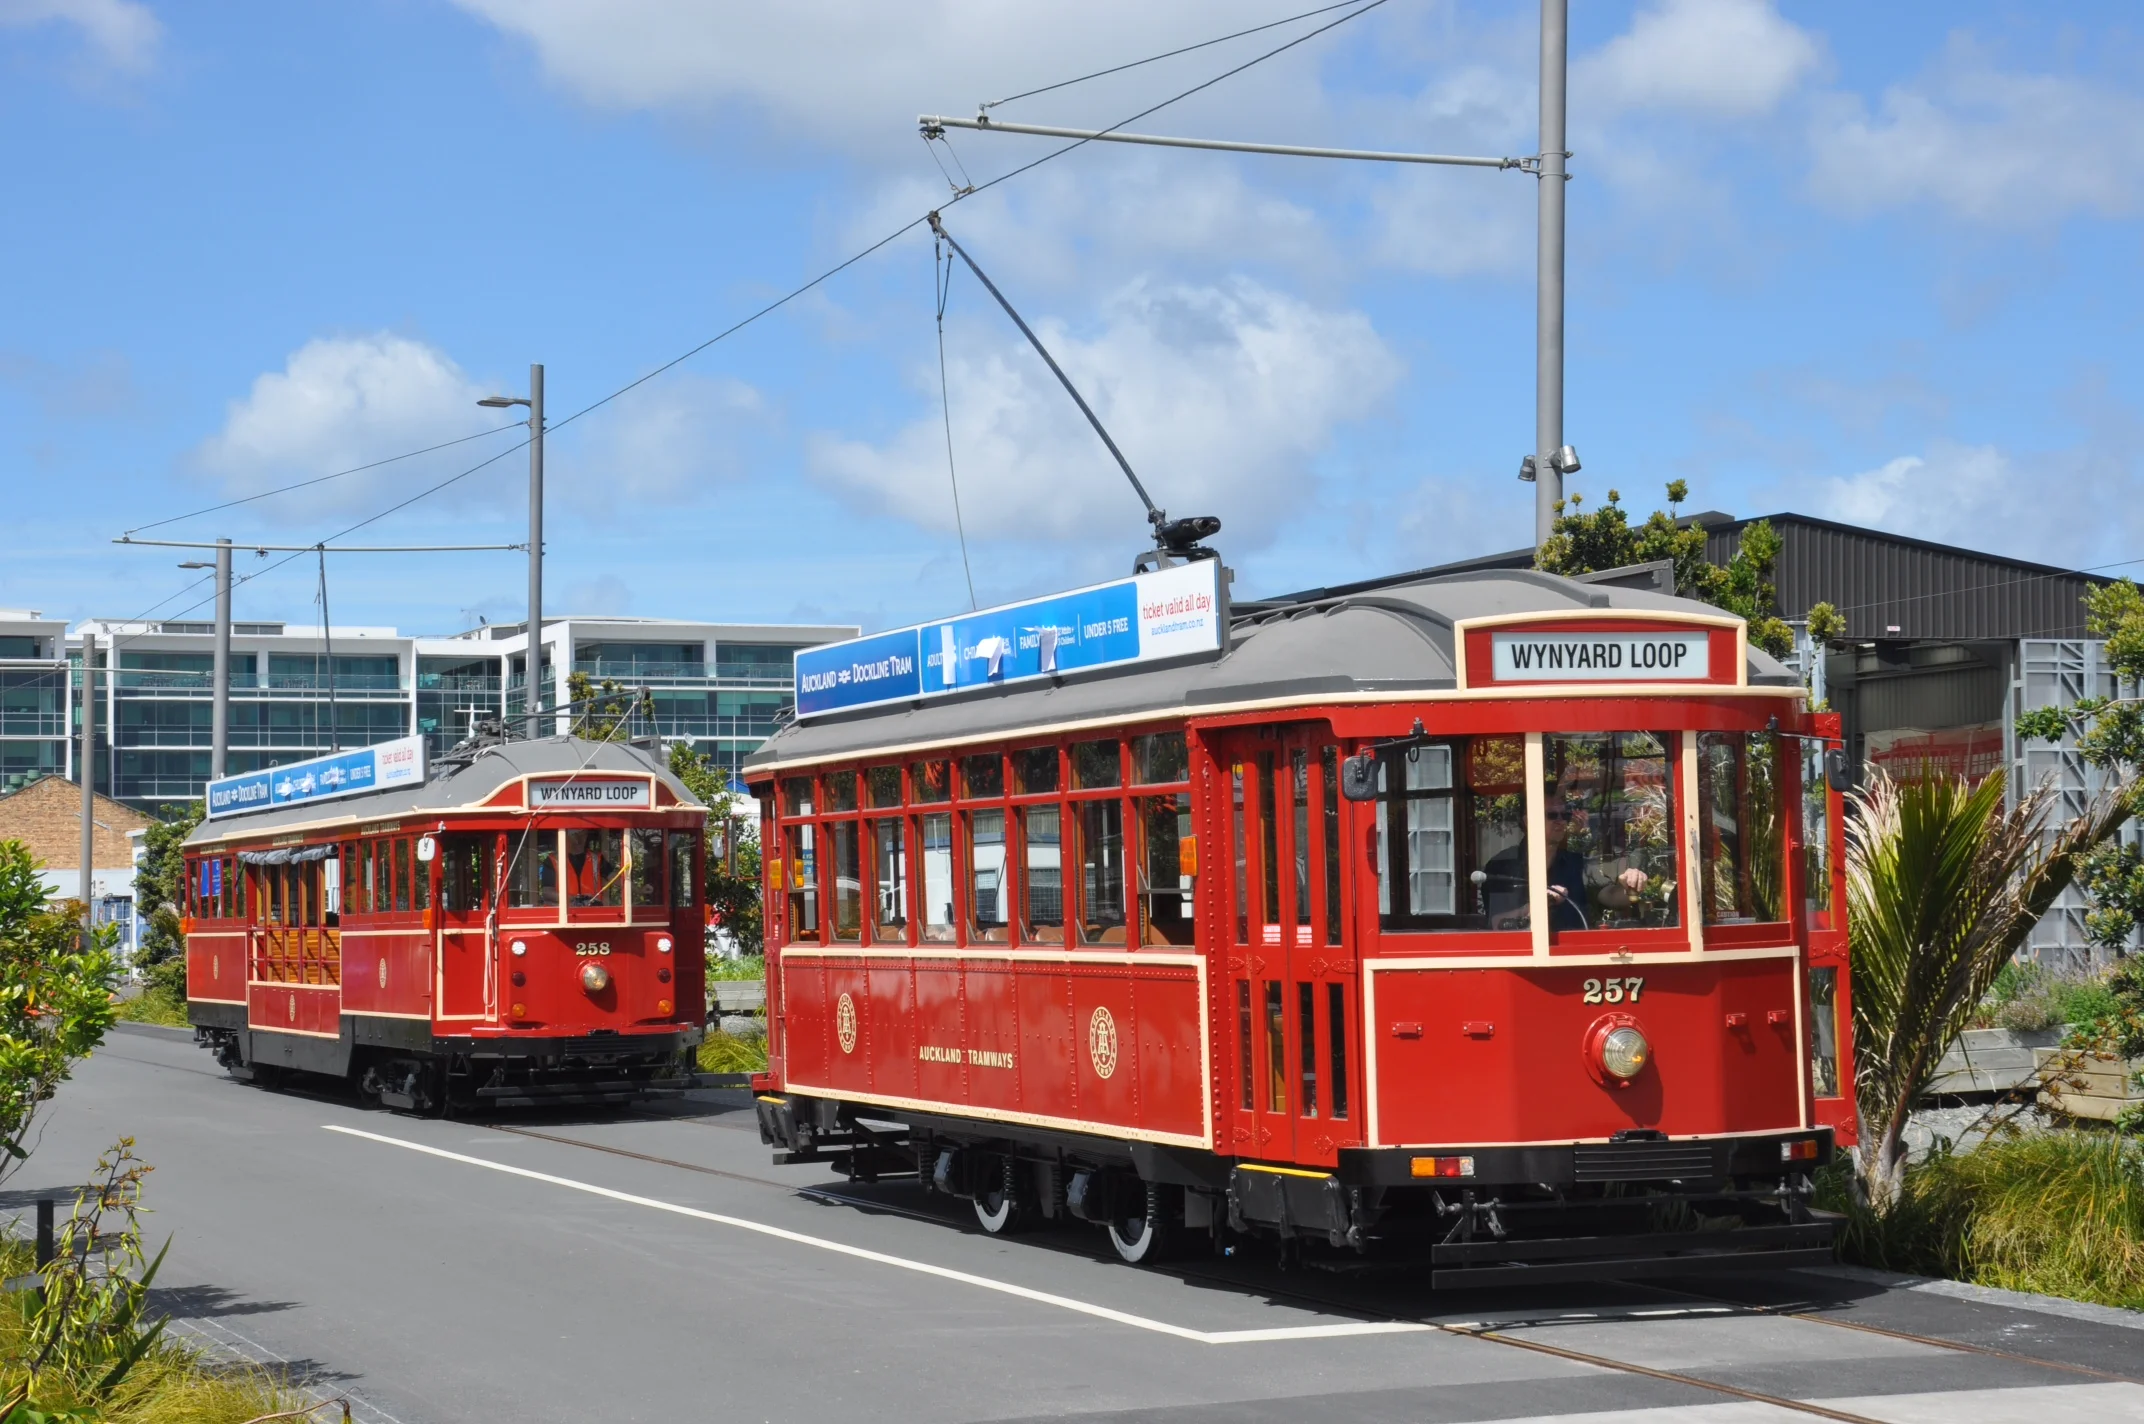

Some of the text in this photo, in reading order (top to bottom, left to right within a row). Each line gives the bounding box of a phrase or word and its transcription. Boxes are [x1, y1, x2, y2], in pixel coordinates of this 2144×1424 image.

[1143, 592, 1212, 620] ticket valid all day
[1084, 617, 1129, 639] UNDER 5 FREE
[1151, 618, 1204, 636] aucklandtram.co.nz
[1020, 633, 1041, 650] FAMILY
[1511, 642, 1687, 669] WYNYARD LOOP
[801, 655, 913, 693] AUCKLAND DOCKLINE TRAM
[212, 789, 231, 807] AUCKLAND
[256, 781, 268, 799] TRAM
[540, 786, 638, 801] WYNYARD LOOP
[576, 942, 611, 956] 258
[1583, 977, 1644, 1004] 257
[919, 1045, 1014, 1069] AUCKLAND TRAMWAYS
